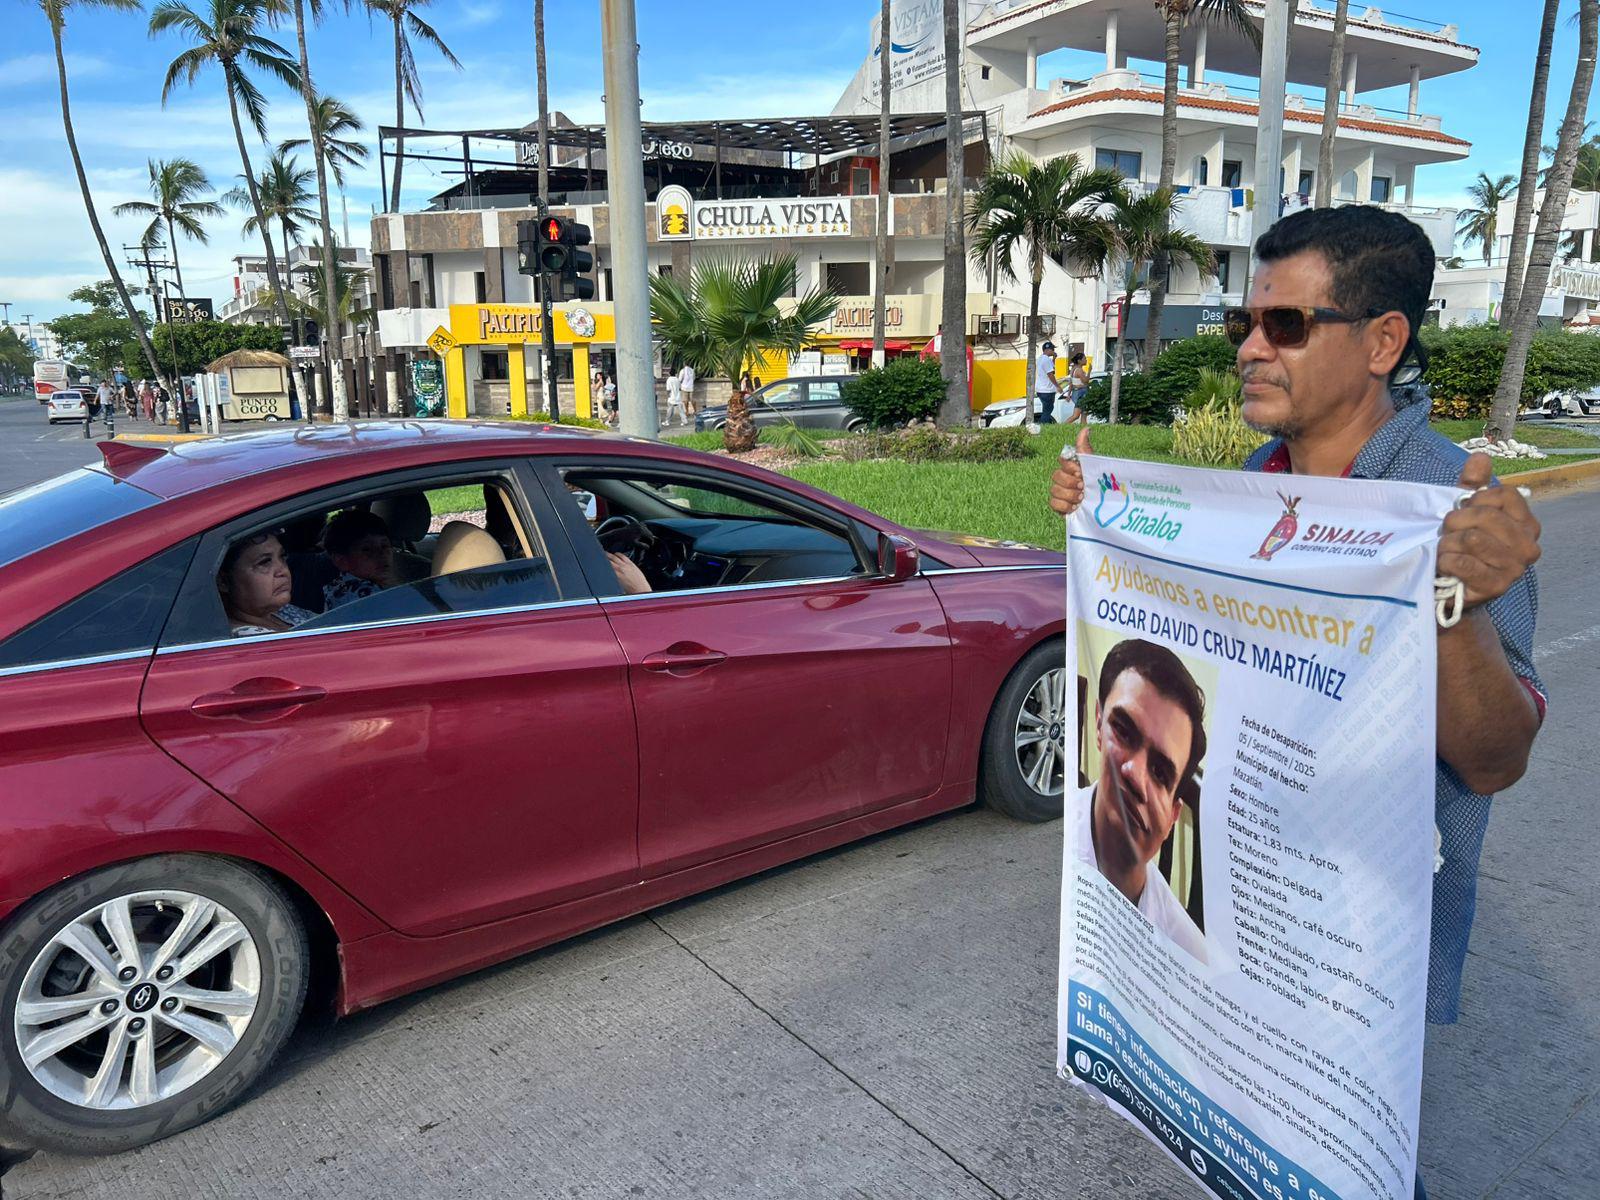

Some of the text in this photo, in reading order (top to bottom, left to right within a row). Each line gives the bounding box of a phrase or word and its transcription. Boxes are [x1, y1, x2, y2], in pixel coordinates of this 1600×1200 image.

[894, 0, 943, 31] VISTAM
[521, 141, 539, 163] Dieg
[697, 203, 848, 227] CHULA VISTA
[697, 224, 849, 237] RESTAURANT & BAR
[478, 308, 542, 340] PACIFIC
[240, 398, 277, 406] PUNTO
[241, 405, 277, 414] COCO
[1120, 507, 1182, 541] Sinaloa
[1302, 523, 1394, 546] SINALOA
[1328, 546, 1342, 554] DEL
[1343, 547, 1378, 558] ESTADO
[1096, 555, 1375, 655] Ayúdanos a encontrar a
[1097, 599, 1346, 701] OSCAR DAVID CRUZ MARTÍNEZ
[1238, 732, 1247, 744] 05
[1252, 738, 1288, 767] Septiembre
[1294, 760, 1316, 777] 2025
[1241, 715, 1317, 759] Fecha de Desaparición:
[1236, 750, 1310, 793] Municipio del hecho:
[1228, 800, 1280, 834] Edad: 25 años
[1229, 783, 1280, 817] Sexo: Hombre
[1227, 817, 1343, 875] Estatura: 1.83 mts. Aprox.
[1227, 834, 1278, 867] Tez: Moreno
[1229, 851, 1323, 902] Complexión: Delgada
[1230, 868, 1287, 903] Cara: Ovalada
[1231, 884, 1363, 953] Ojos: Medianos, café oscuro
[1232, 899, 1286, 934] Nariz: Ancha
[1075, 957, 1095, 971] actual
[1076, 946, 1087, 956] por
[1234, 916, 1395, 1010] Cabello: Ondulado, castaño oscuro
[1236, 931, 1308, 978] Frente: Mediana
[1238, 947, 1371, 1028] Boca: Grande, labios gruesos
[1239, 963, 1306, 1009] Cejas: Pobladas
[1076, 933, 1092, 946] Visto
[1093, 943, 1103, 953] por
[1196, 1040, 1207, 1053] del
[1227, 1064, 1252, 1086] siendo
[1253, 1080, 1265, 1095] las
[1266, 1089, 1291, 1110] 11:00
[1291, 1105, 1316, 1128] horas
[1189, 973, 1201, 985] con
[1202, 980, 1213, 993] las
[1215, 990, 1241, 1013] mangas
[1251, 1015, 1259, 1025] el
[1261, 1022, 1287, 1041] cuello
[1290, 1038, 1308, 1052] con
[1312, 1049, 1335, 1068] rayas
[1339, 1065, 1351, 1079] de
[1354, 1076, 1375, 1097] color
[1199, 993, 1215, 1008] color
[1216, 1003, 1239, 1026] blanco
[1240, 1022, 1255, 1035] con
[1275, 1043, 1302, 1064] marca
[1305, 1058, 1325, 1077] Nike
[1327, 1072, 1341, 1088] del
[1343, 1083, 1376, 1114] numero
[1076, 1012, 1113, 1045] llama
[1114, 1041, 1120, 1054] o
[1189, 1110, 1209, 1138] Tu
[1213, 1133, 1259, 1183] ayuda
[1262, 1177, 1283, 1200] es
[1077, 991, 1092, 1011] Si
[1098, 1001, 1127, 1042] tienes
[1130, 1033, 1201, 1113] información
[1207, 1108, 1279, 1176] referente
[1288, 1173, 1300, 1191] a
[1219, 1033, 1246, 1056] Cuenta
[1247, 1052, 1262, 1066] con
[1263, 1062, 1279, 1077] una
[1280, 1072, 1310, 1096] cicatriz
[1312, 1091, 1346, 1120] ubicada
[1348, 1117, 1359, 1131] en
[1360, 1125, 1375, 1145] una
[1156, 1116, 1184, 1151] 8424
[1234, 1082, 1245, 1093] de
[1285, 1115, 1319, 1144] Sinaloa,
[1321, 1140, 1378, 1196] desconociendo
